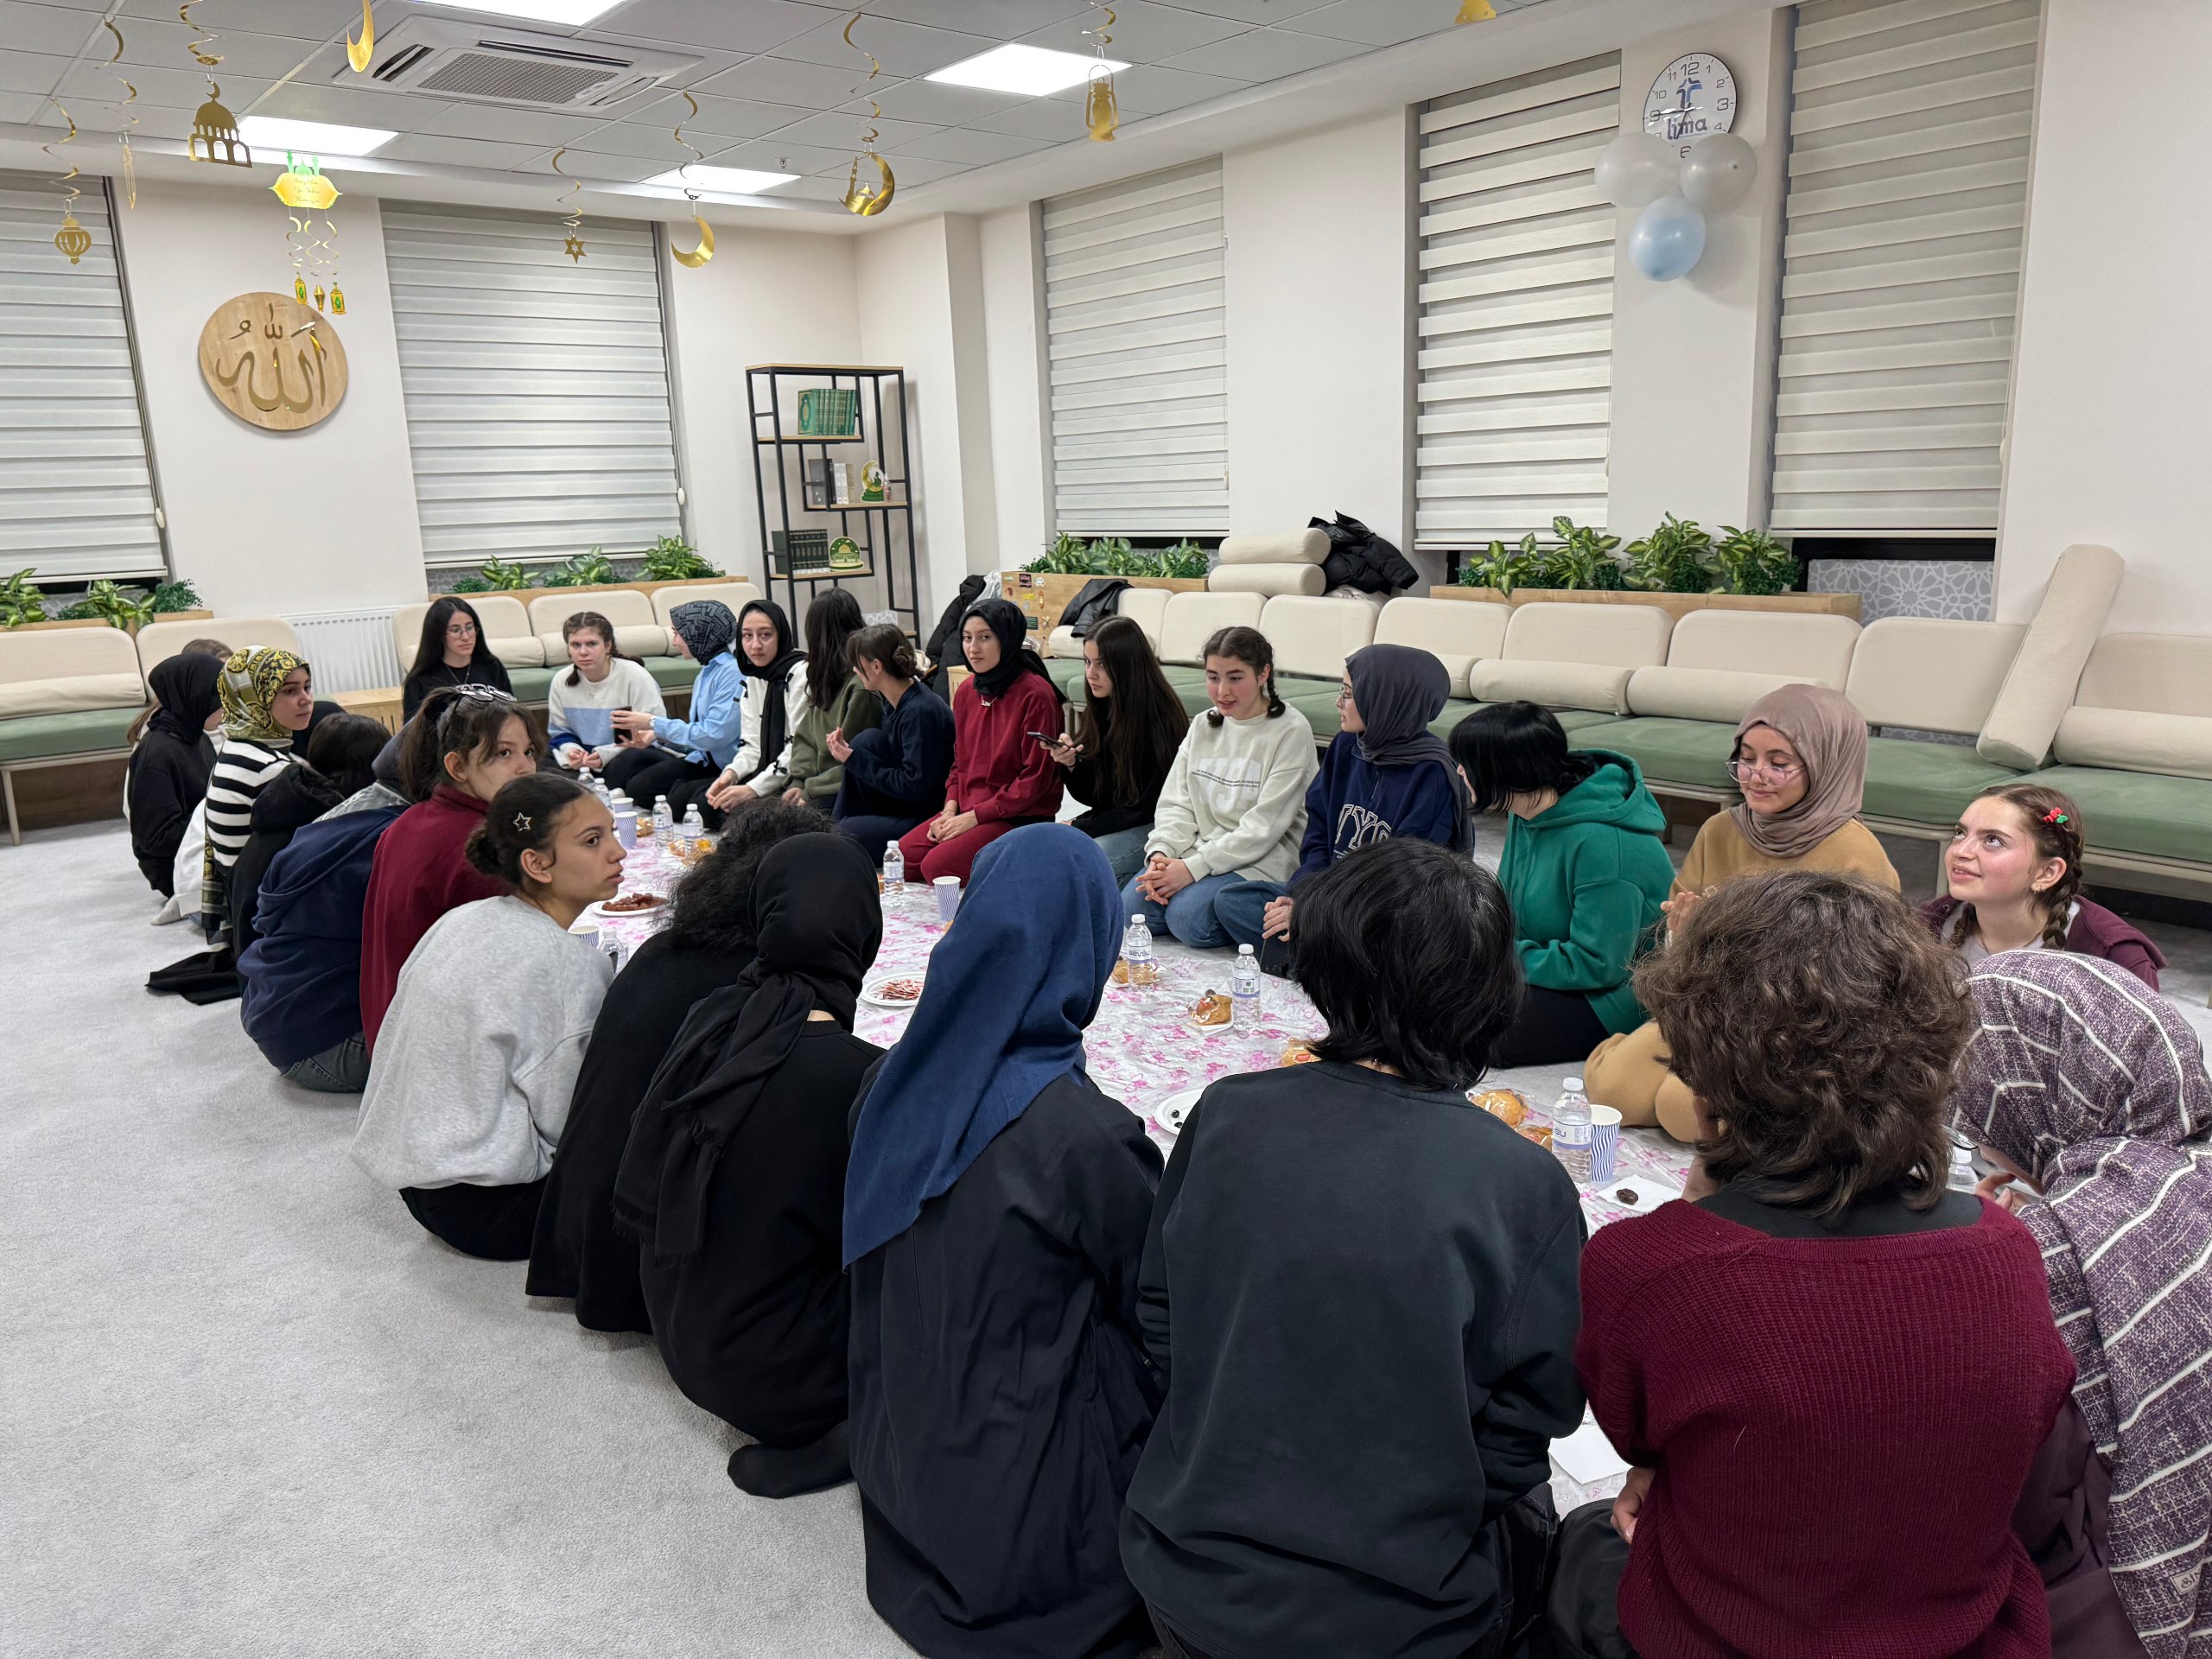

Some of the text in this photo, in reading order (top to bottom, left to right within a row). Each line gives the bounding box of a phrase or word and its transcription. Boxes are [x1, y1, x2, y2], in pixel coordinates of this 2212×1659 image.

[1681, 61, 1700, 76] 12
[1706, 65, 1711, 73] 1
[1667, 72, 1677, 81] 11
[1716, 79, 1726, 88] 2
[1654, 90, 1667, 99] 10
[1717, 98, 1729, 111] 3
[1649, 110, 1661, 122] 9
